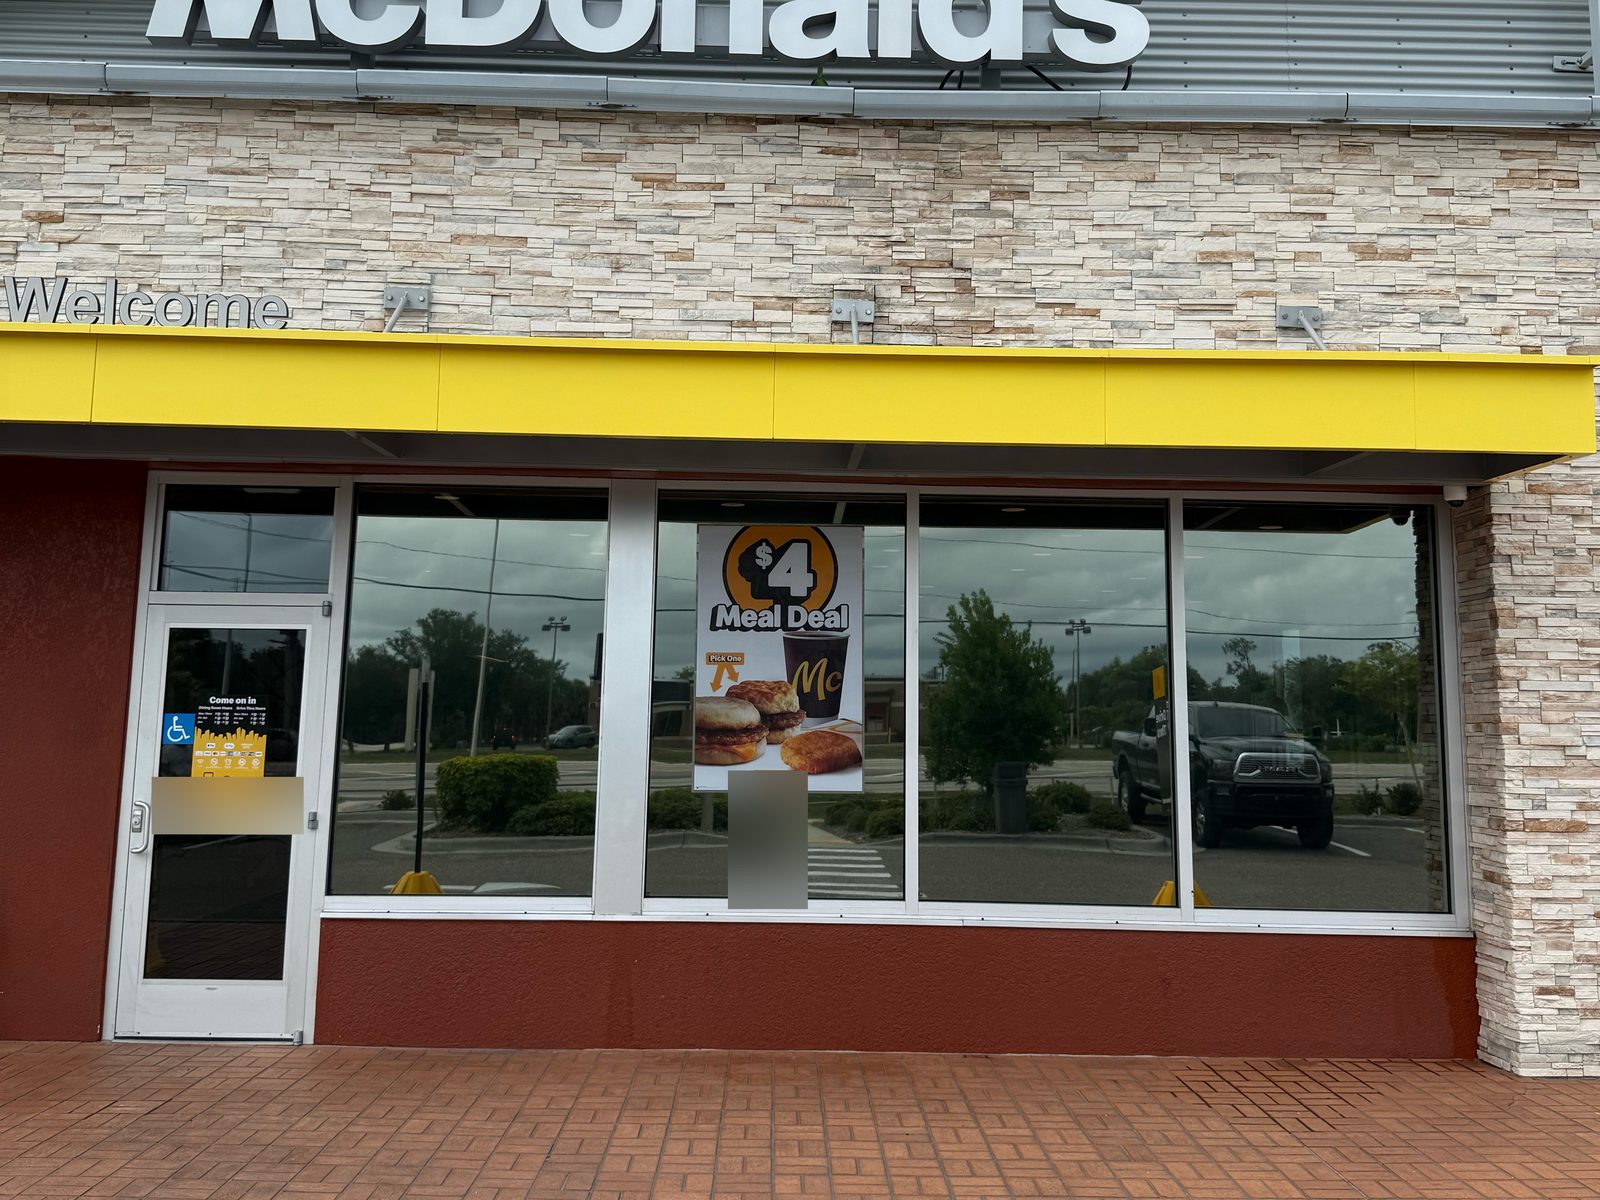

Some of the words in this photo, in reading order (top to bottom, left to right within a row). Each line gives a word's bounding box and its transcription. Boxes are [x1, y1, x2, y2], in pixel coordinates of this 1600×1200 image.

[2, 275, 289, 329] Welcome
[754, 541, 814, 598] $4
[713, 603, 782, 629] Meal
[787, 603, 849, 629] Deal
[709, 654, 726, 662] Pick
[726, 654, 742, 662] One
[209, 696, 234, 704] Come
[247, 696, 257, 704] in
